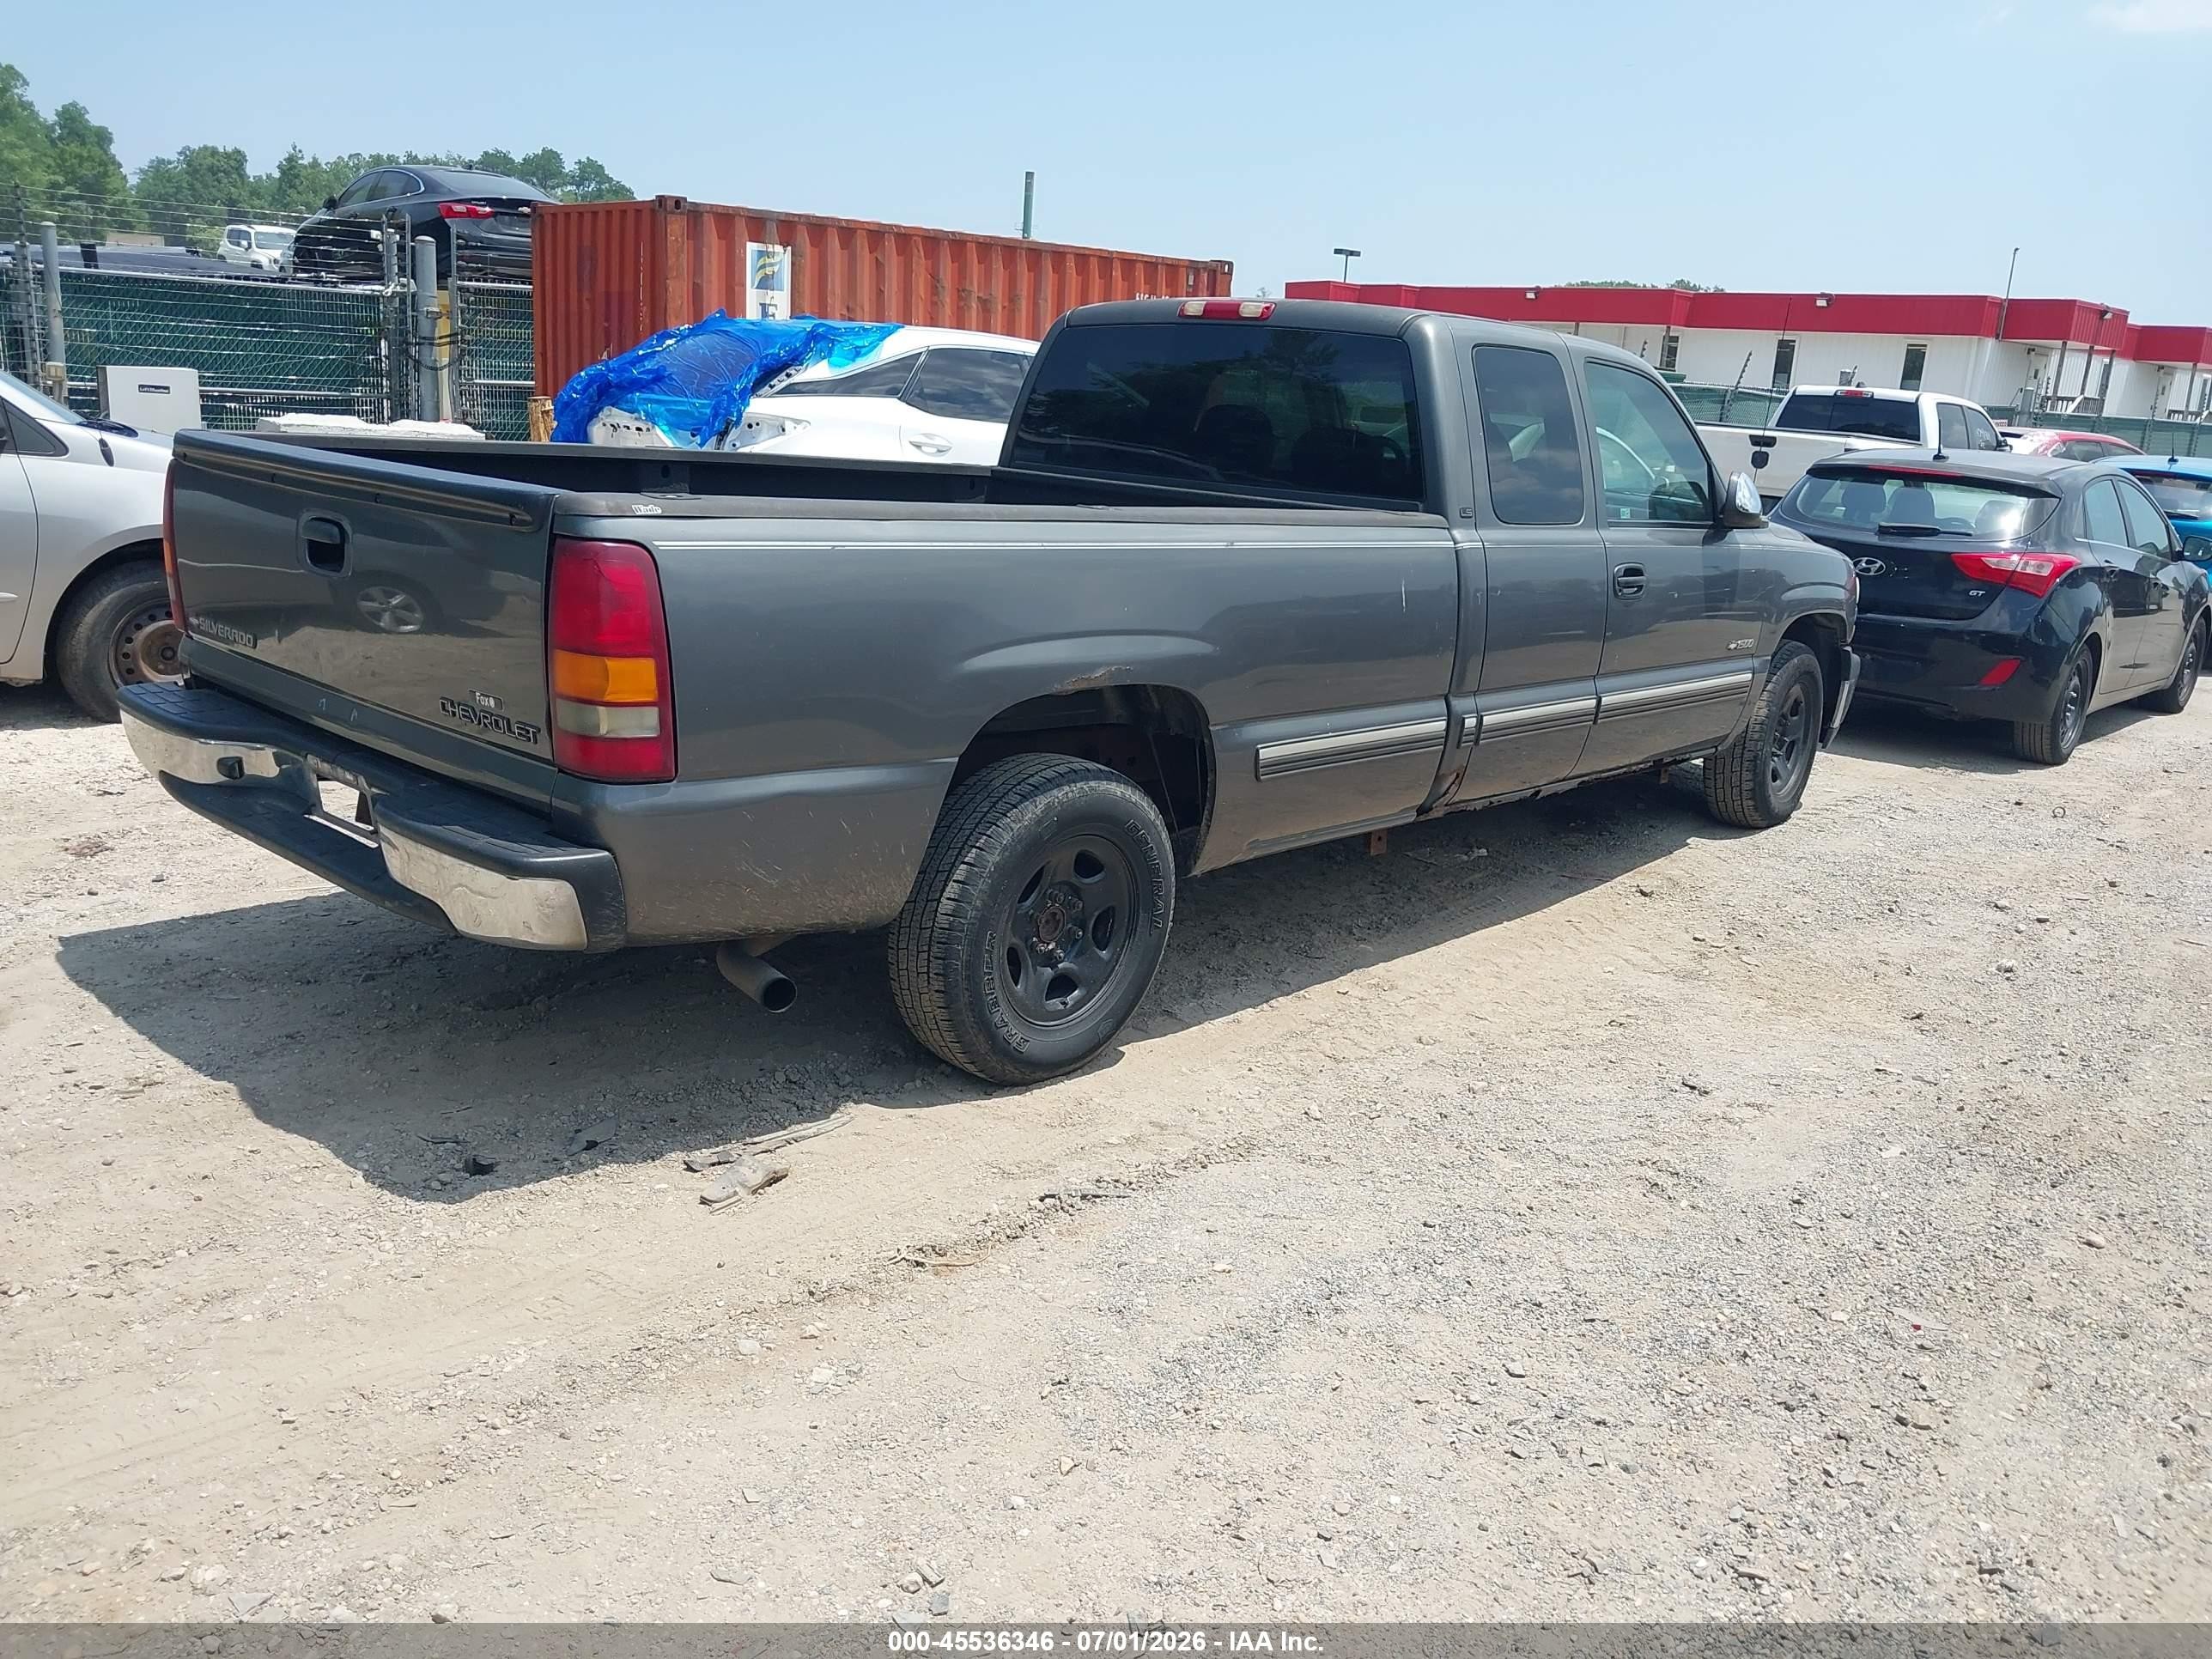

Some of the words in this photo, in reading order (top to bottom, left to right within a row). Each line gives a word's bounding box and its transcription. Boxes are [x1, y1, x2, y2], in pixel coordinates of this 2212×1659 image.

[631, 504, 662, 515] Wade
[1460, 507, 1473, 519] LS
[1968, 589, 1985, 598] GT
[198, 616, 258, 649] SILVERADO
[1736, 638, 1755, 650] 1500
[439, 696, 542, 745] CHEVROLET
[1124, 818, 1165, 931] GENERAL
[981, 929, 1031, 1054] GRABBER
